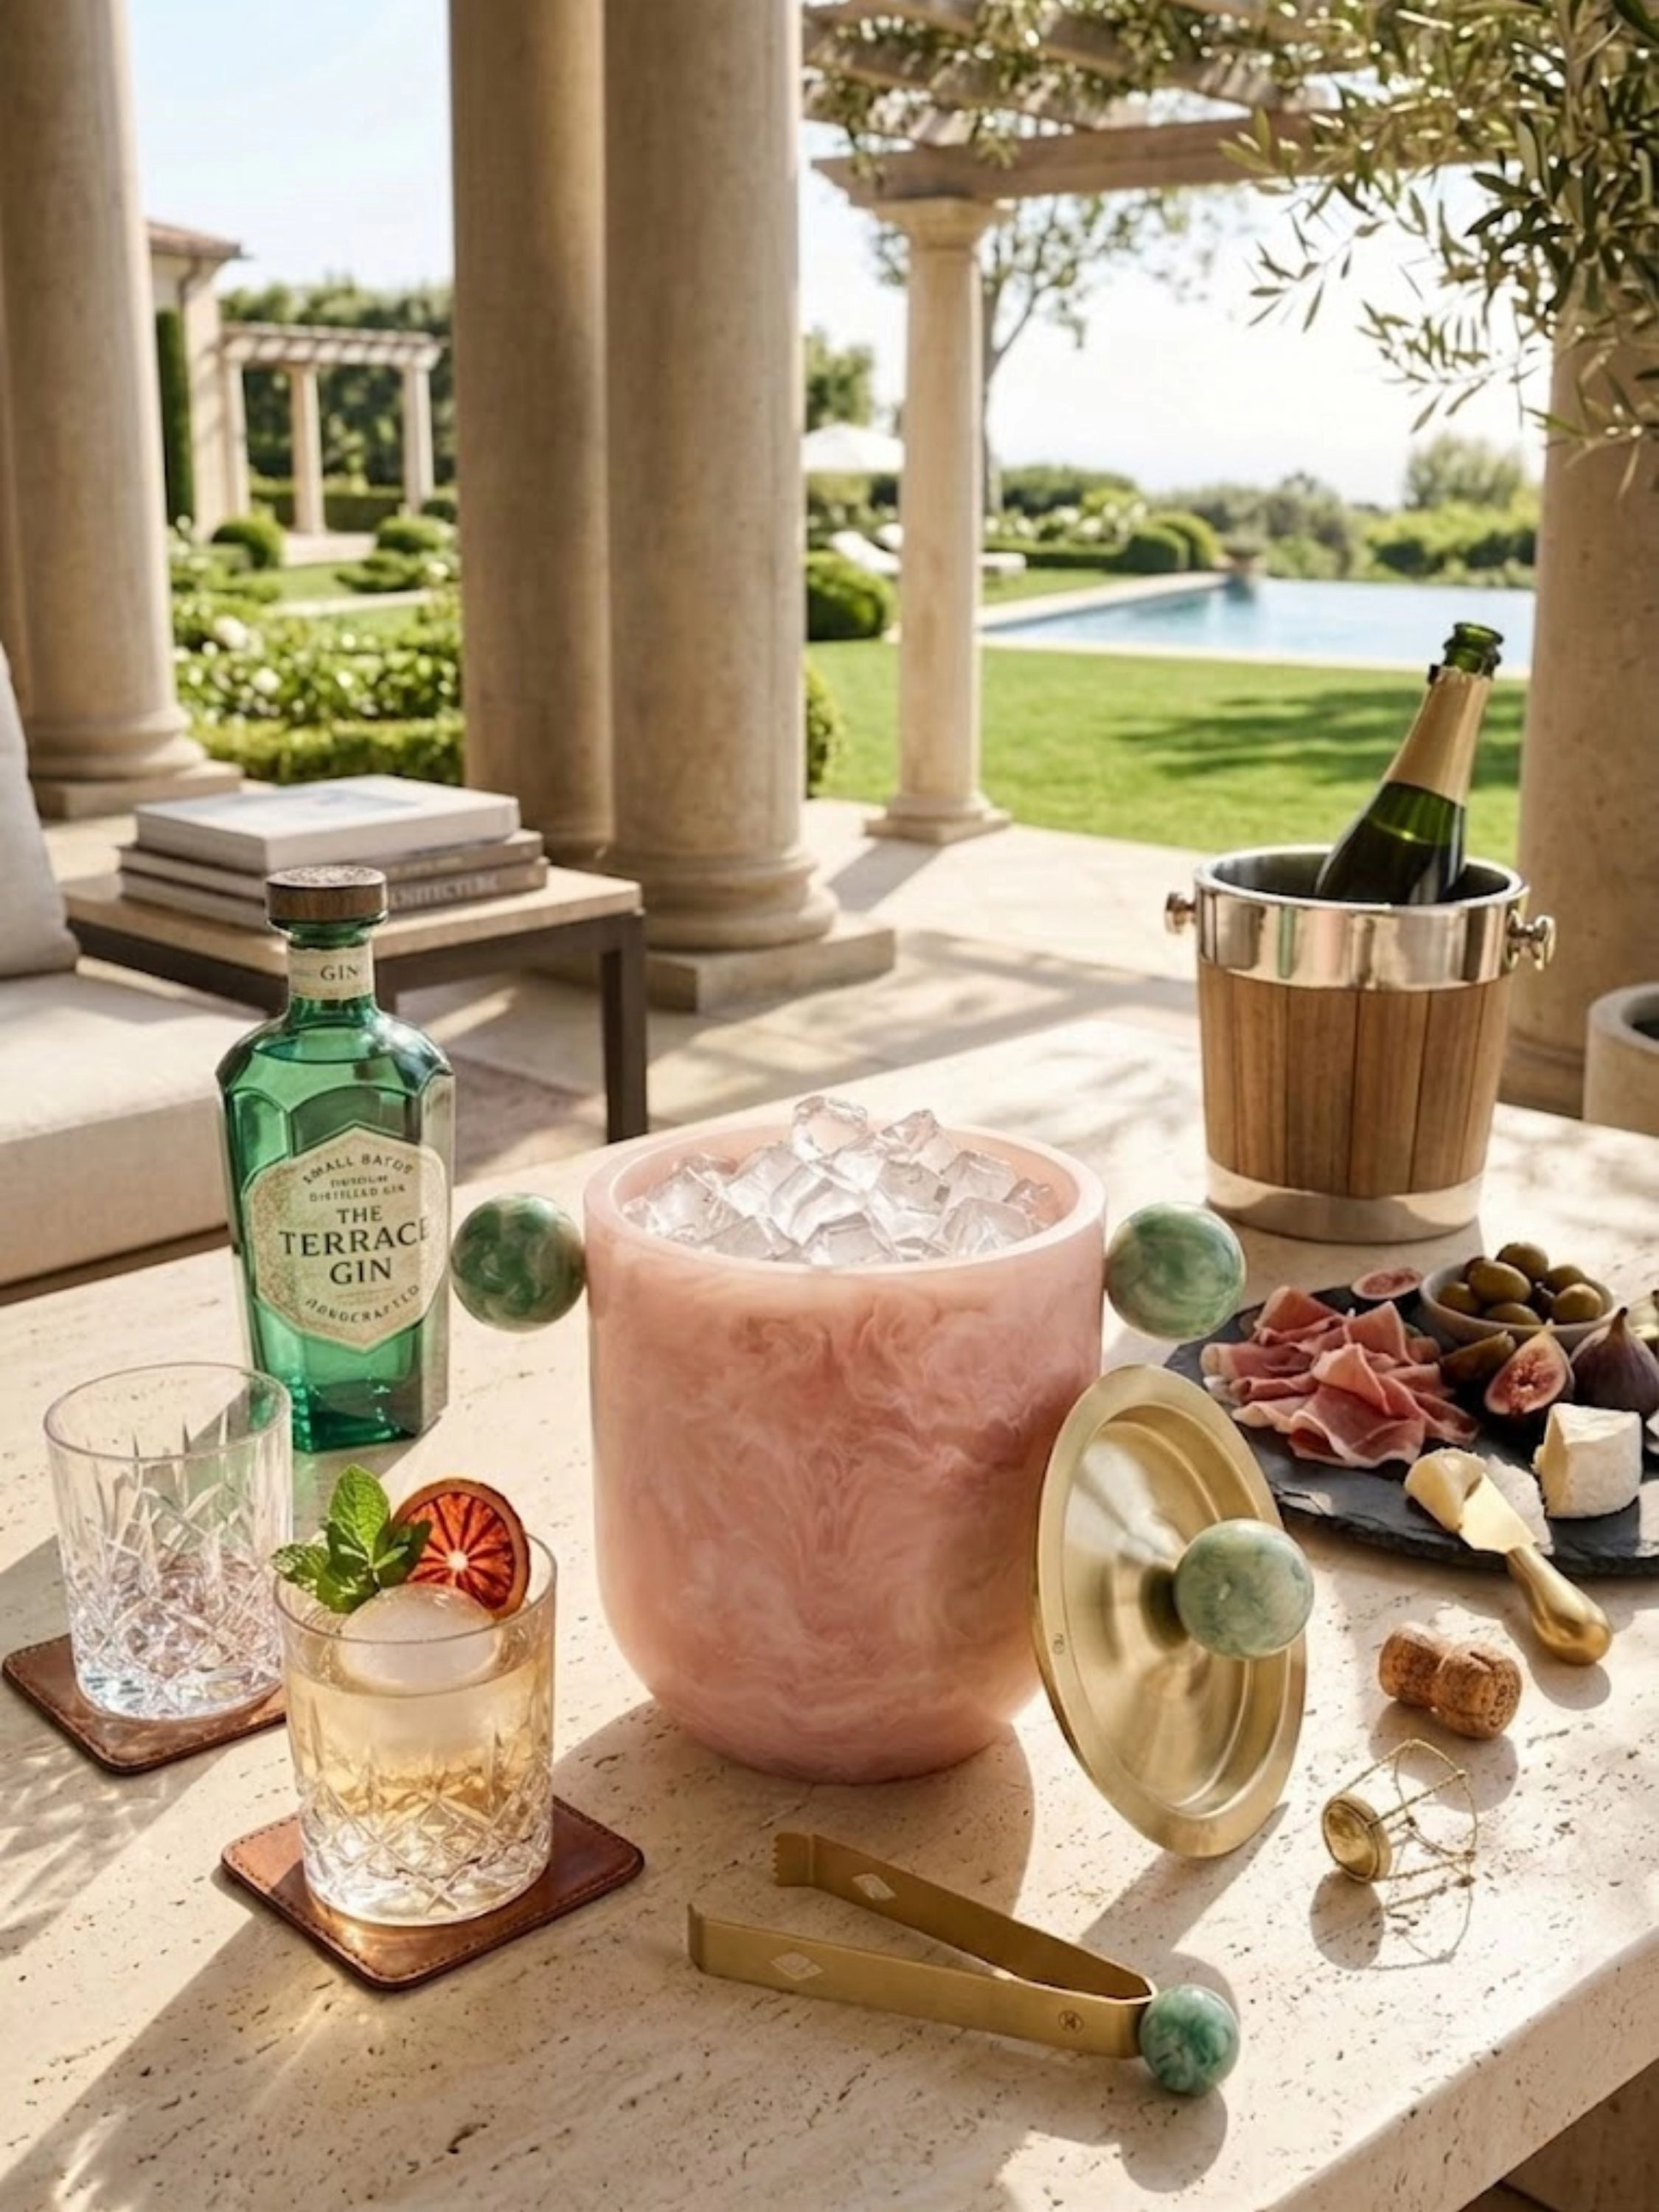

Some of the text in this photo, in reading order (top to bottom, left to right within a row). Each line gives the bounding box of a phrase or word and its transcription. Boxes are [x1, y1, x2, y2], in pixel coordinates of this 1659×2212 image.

[321, 964, 358, 981] GIN
[336, 1206, 382, 1224] THE
[279, 1218, 429, 1256] TERRACE
[330, 1257, 392, 1285] GIN
